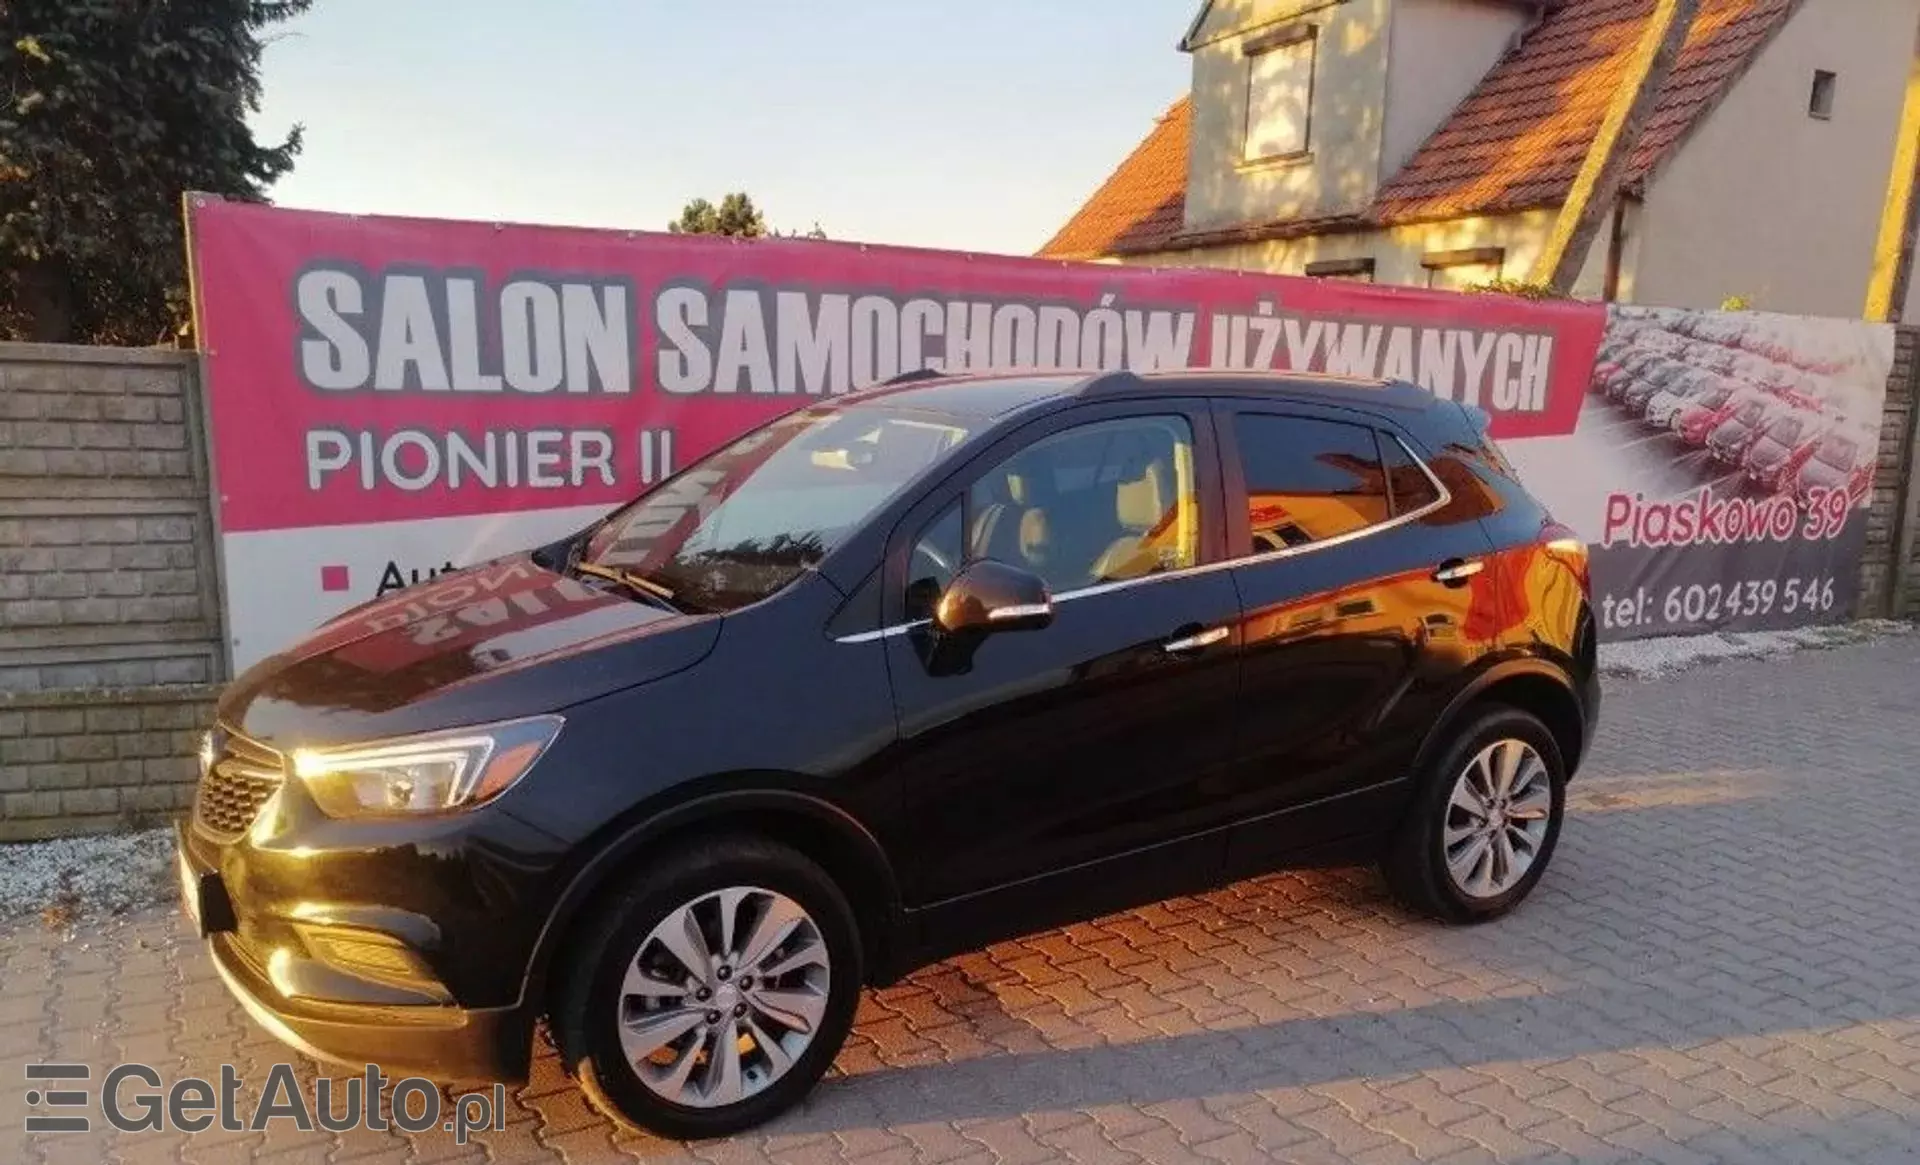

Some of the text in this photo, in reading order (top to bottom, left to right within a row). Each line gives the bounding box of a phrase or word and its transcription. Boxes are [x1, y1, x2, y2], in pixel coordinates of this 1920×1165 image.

[298, 268, 630, 394] SALON
[657, 286, 1195, 394] SAMOCHODÓW
[308, 429, 672, 489] PIONIER II
[1602, 486, 1852, 547] Piaskowo 39
[1602, 588, 1651, 629] tel:
